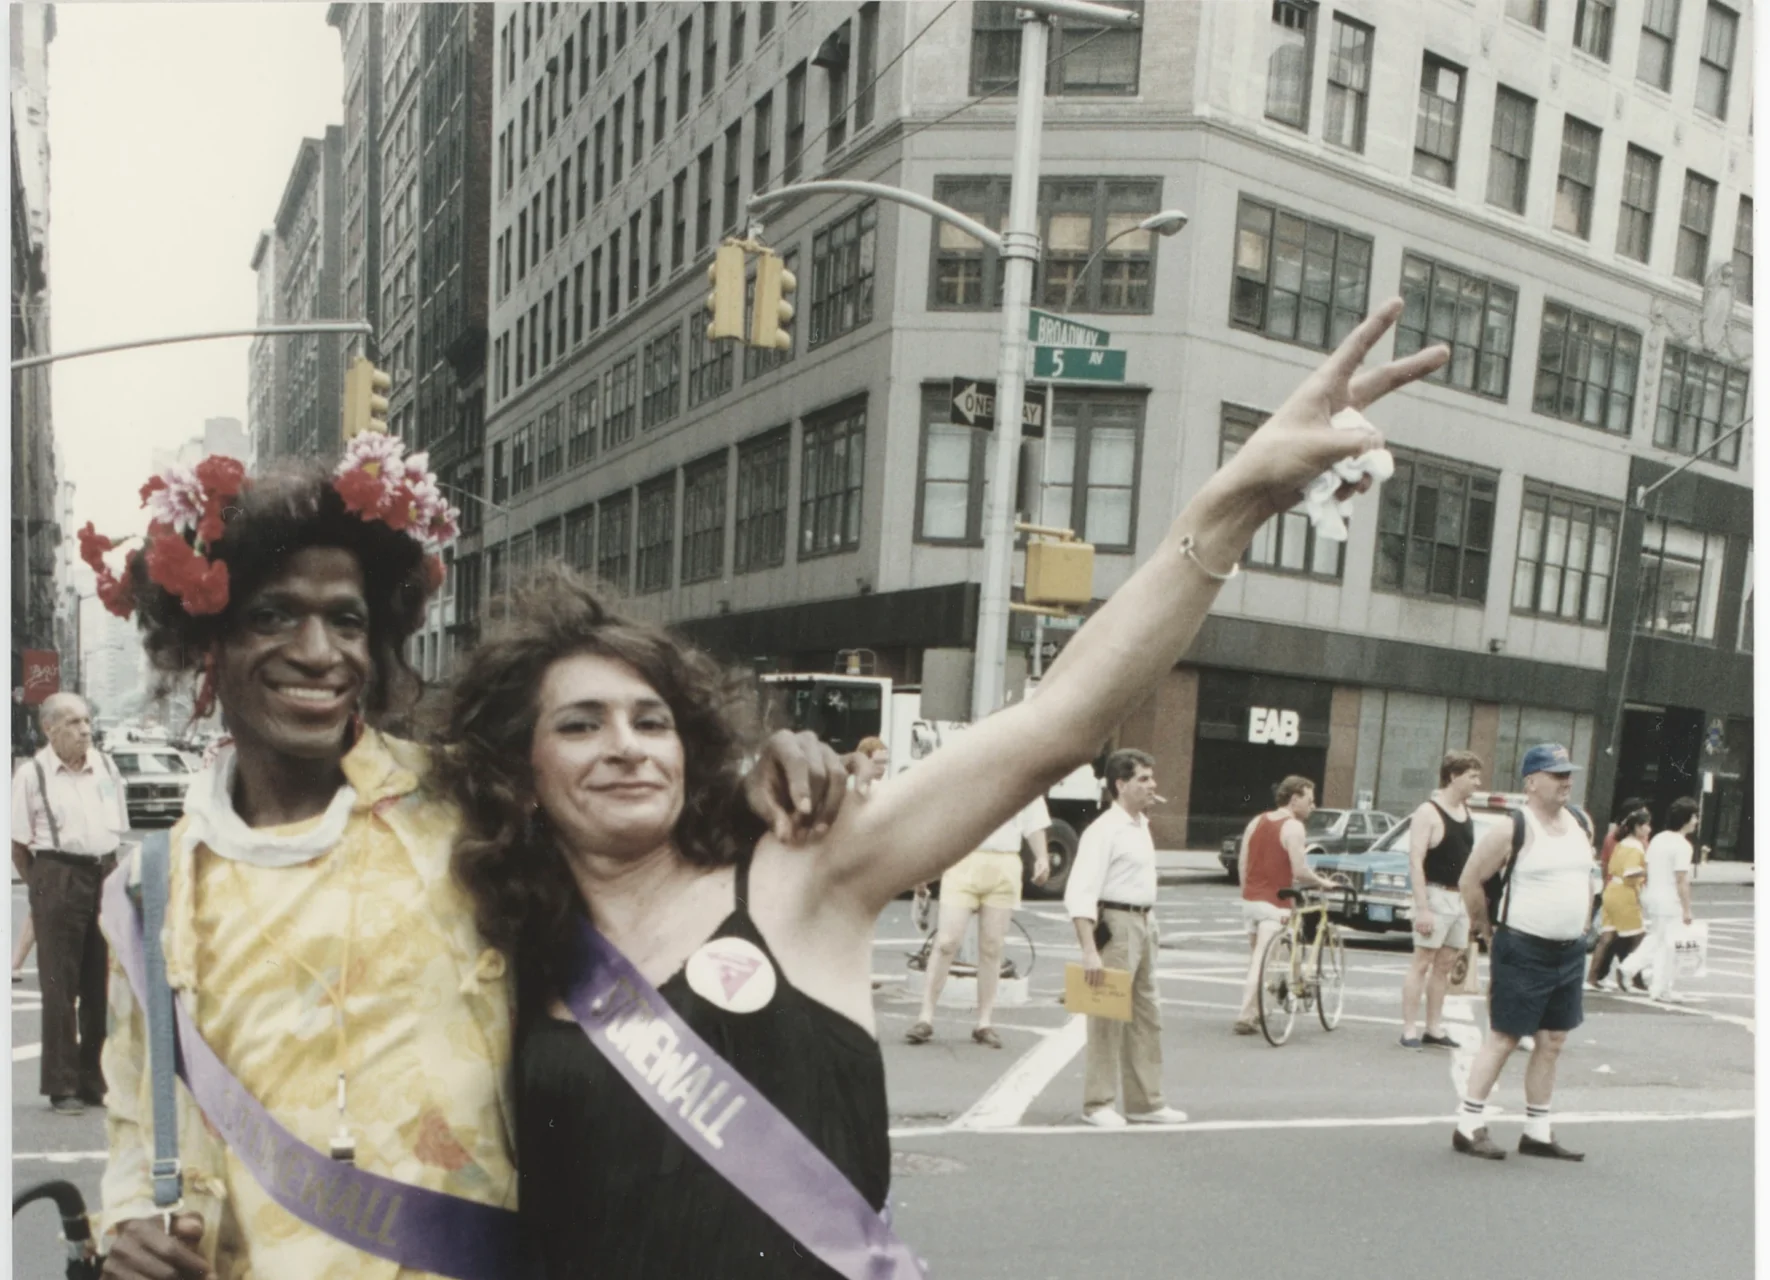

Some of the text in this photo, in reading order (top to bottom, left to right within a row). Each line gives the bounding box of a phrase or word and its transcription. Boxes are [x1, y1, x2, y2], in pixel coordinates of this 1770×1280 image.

[1038, 316, 1099, 346] BROADWAY
[1052, 349, 1104, 377] 5 AV
[965, 393, 995, 417] ONE
[1248, 706, 1300, 747] EAB
